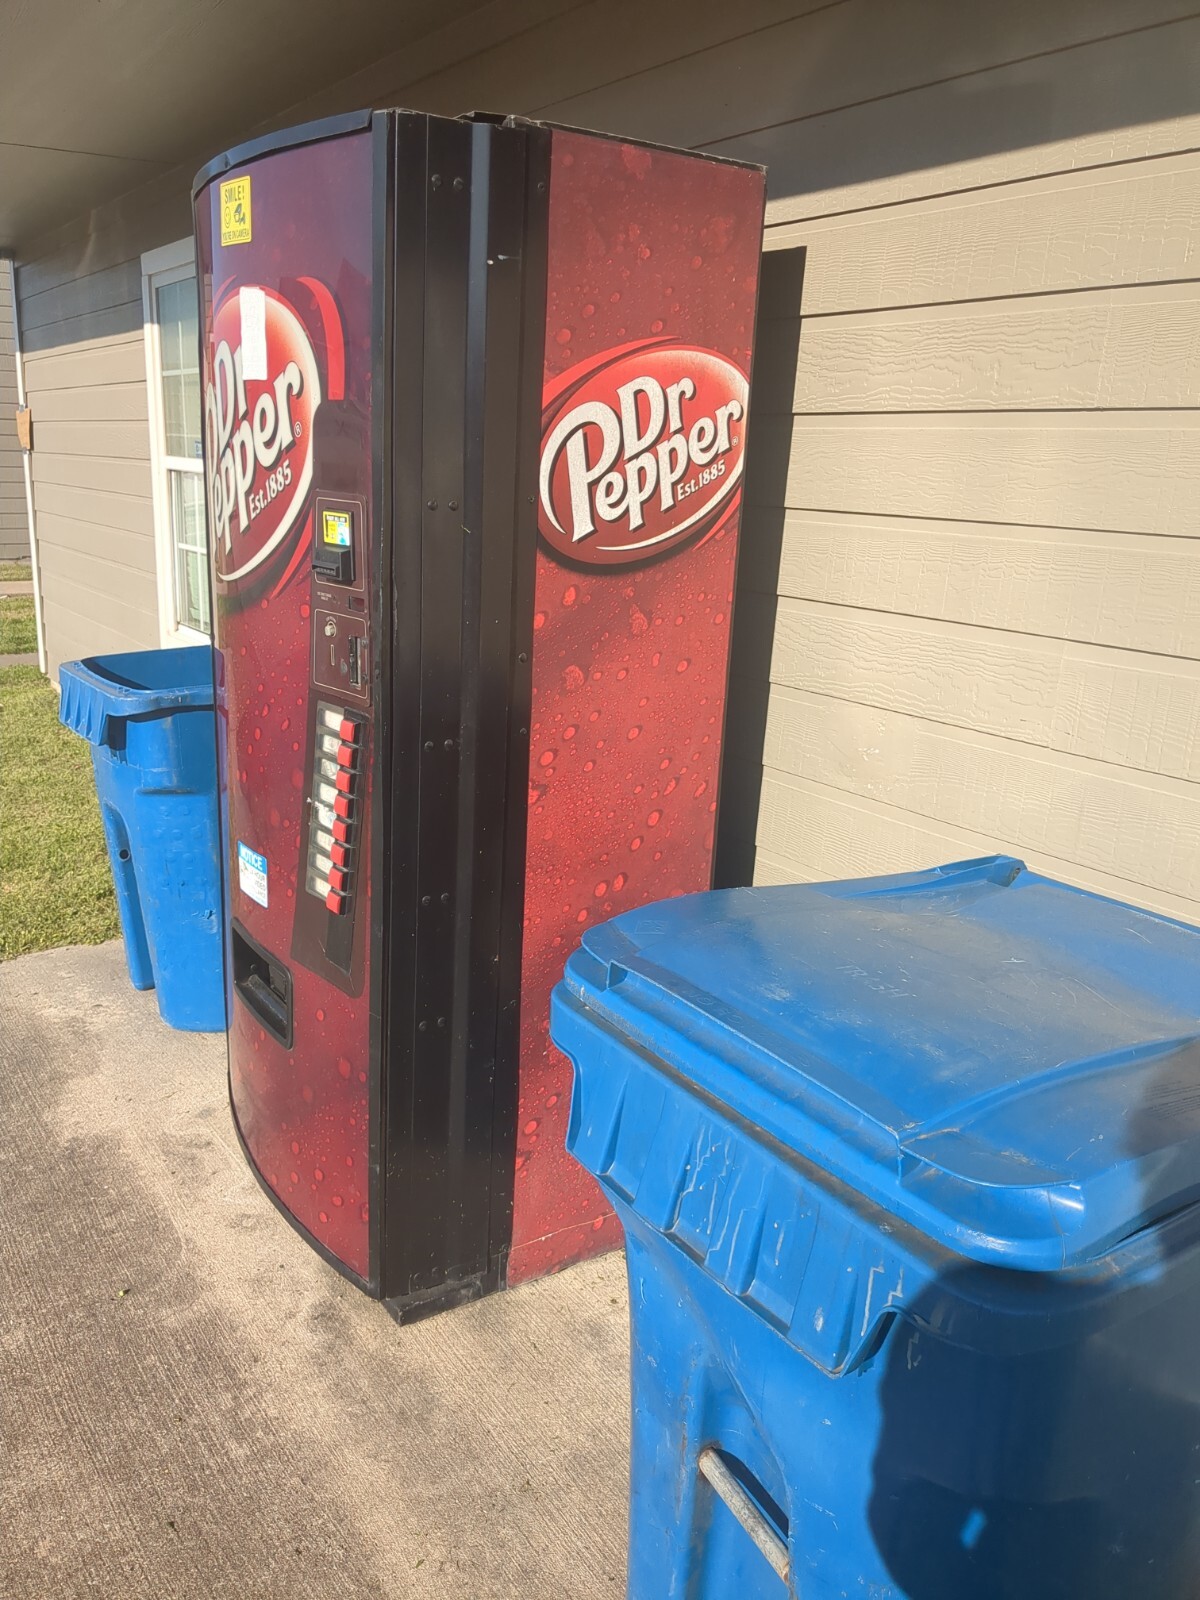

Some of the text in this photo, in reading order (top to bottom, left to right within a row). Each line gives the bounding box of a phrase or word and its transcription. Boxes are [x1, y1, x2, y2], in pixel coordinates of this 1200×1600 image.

[616, 376, 695, 461] Dr
[539, 400, 742, 543] Pepper
[240, 844, 263, 871] NOTICE
